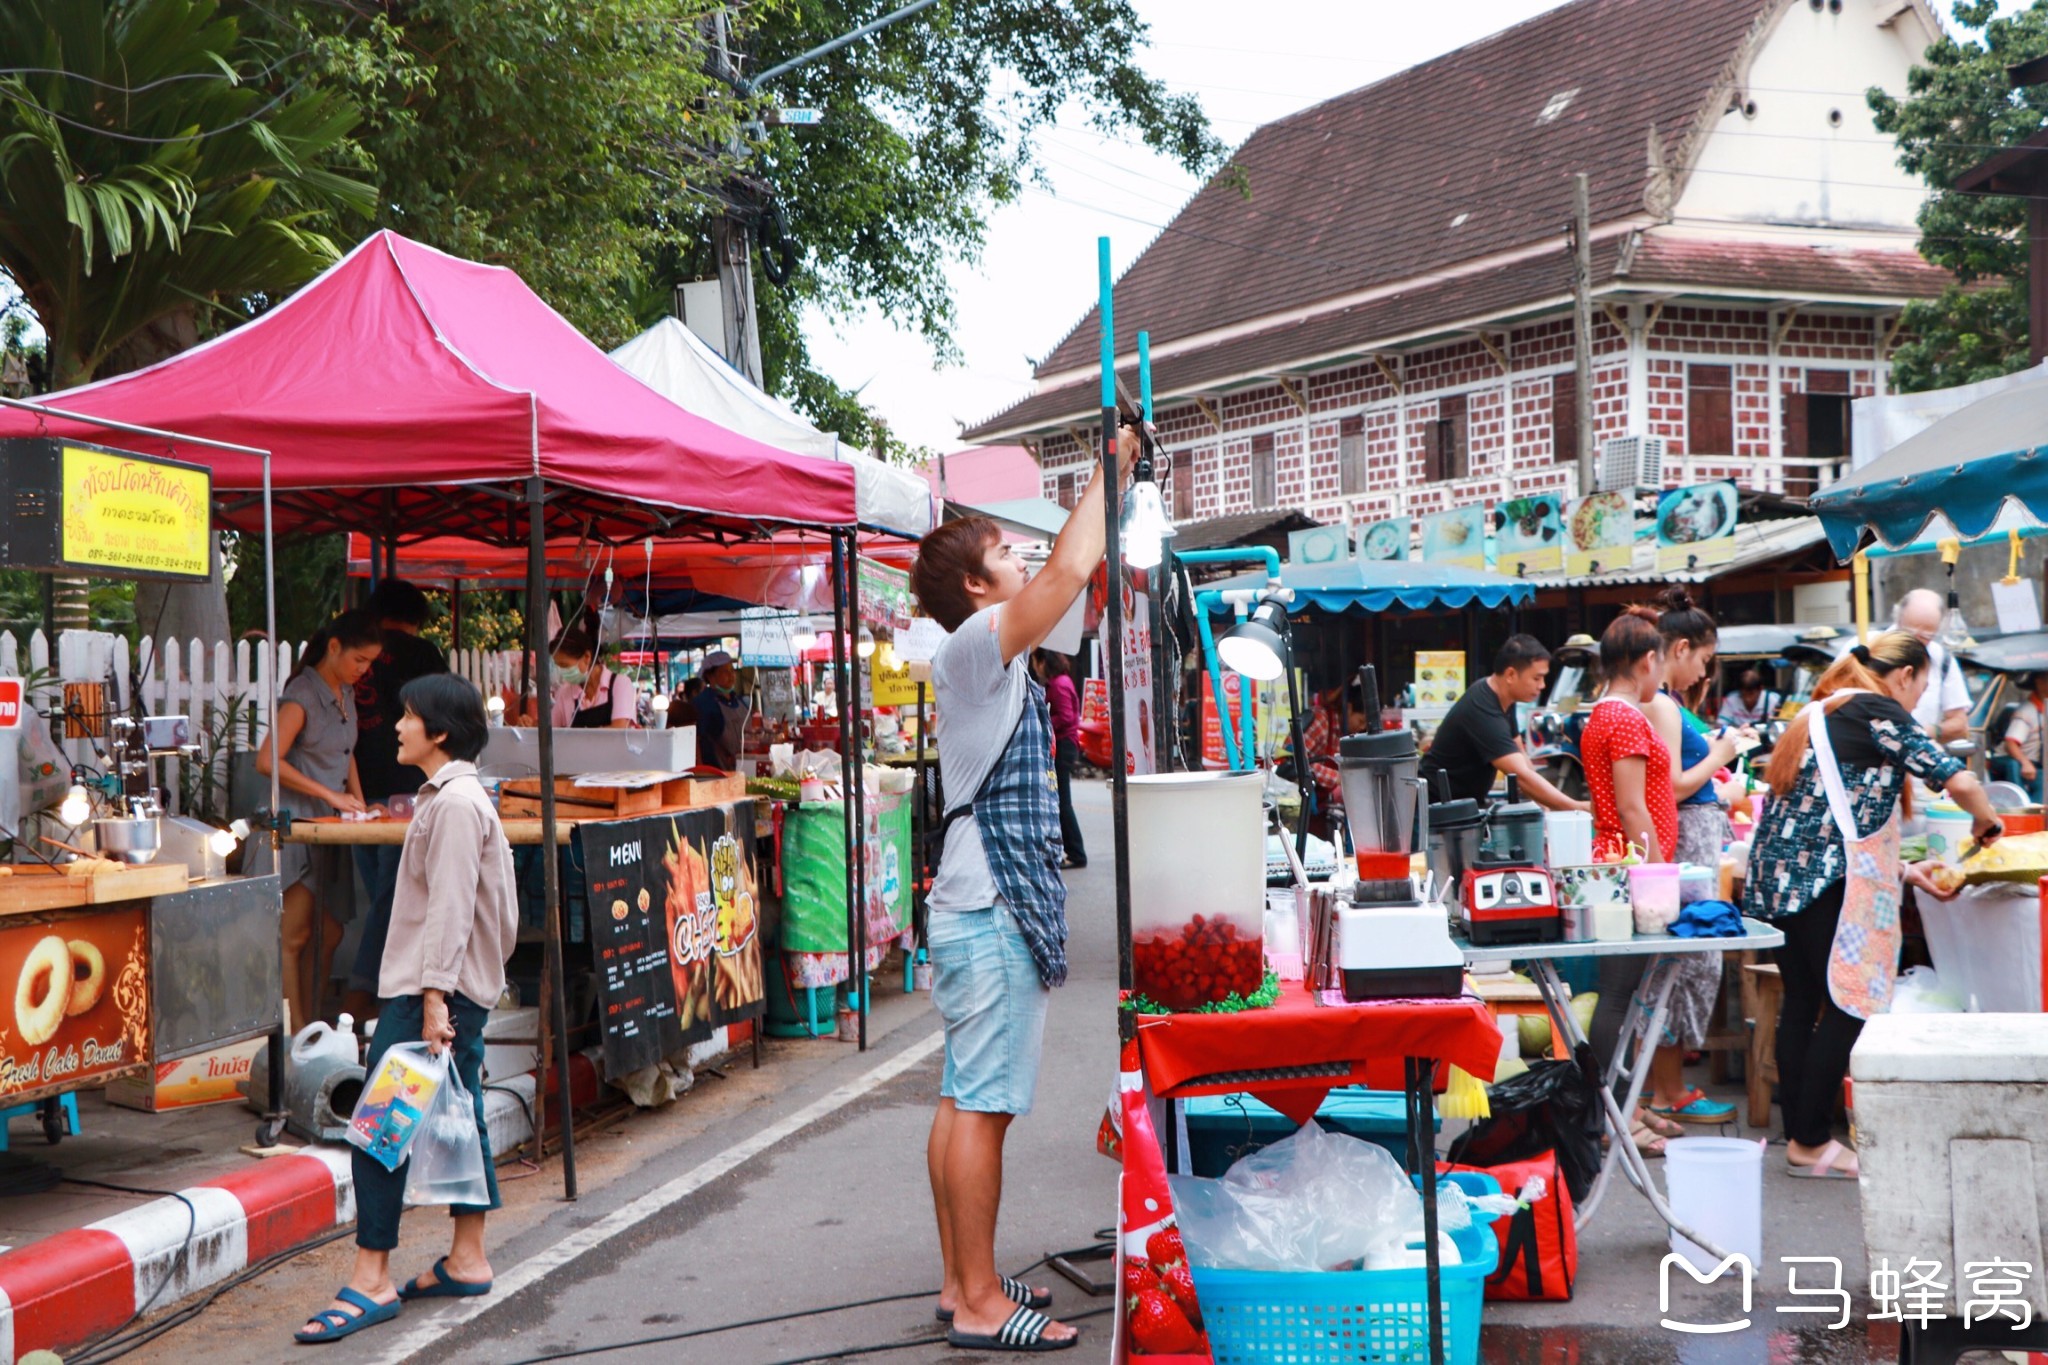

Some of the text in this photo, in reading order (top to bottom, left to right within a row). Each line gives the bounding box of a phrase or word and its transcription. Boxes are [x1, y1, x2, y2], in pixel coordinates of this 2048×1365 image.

[610, 840, 642, 867] MENU
[1, 1037, 123, 1092] Fresh Cake Donut
[208, 1056, 249, 1078] โบนัส
